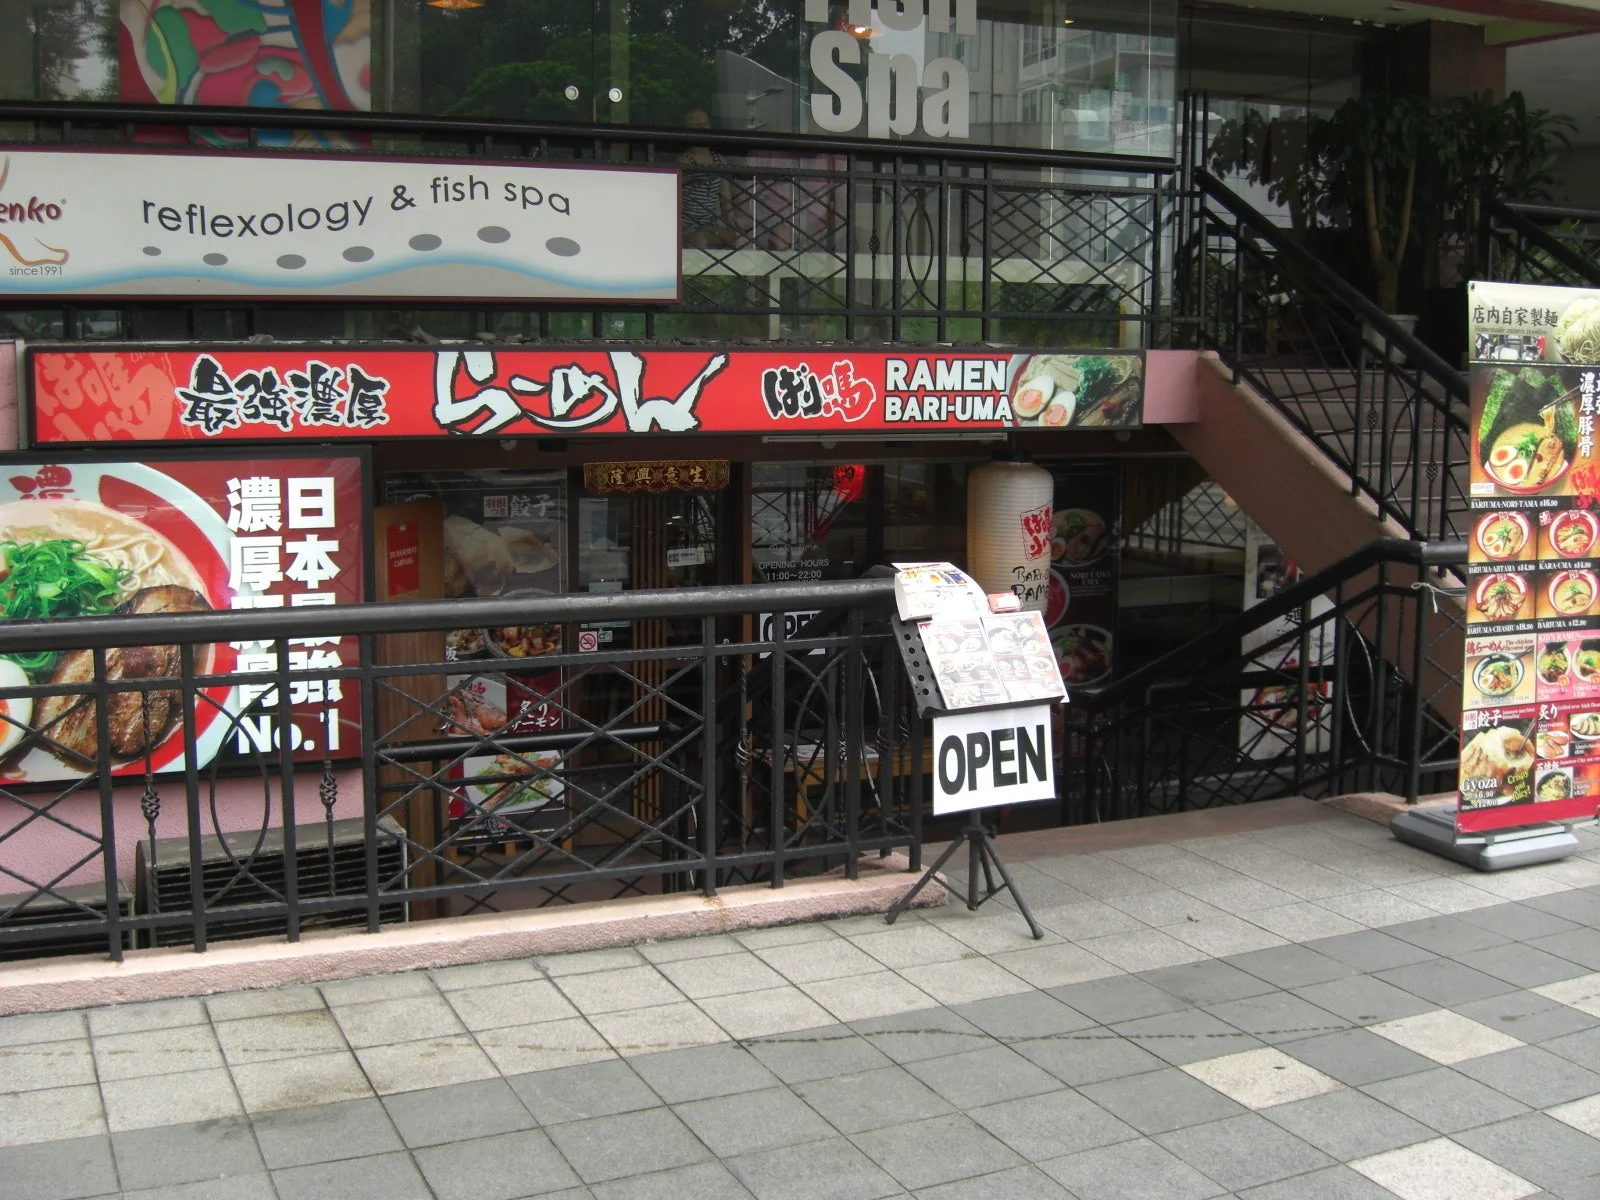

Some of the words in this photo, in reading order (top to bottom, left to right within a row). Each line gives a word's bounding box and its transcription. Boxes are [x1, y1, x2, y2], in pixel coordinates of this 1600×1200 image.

[810, 30, 969, 139] Spa
[142, 197, 373, 238] reflexology
[390, 184, 417, 211] &
[430, 174, 489, 204] fish
[504, 181, 571, 216] spa
[1472, 304, 1559, 328] 店内自家製麺
[885, 359, 1007, 391] RAMEN
[176, 355, 389, 435] 最強濃厚
[432, 351, 728, 435] らーめん
[884, 395, 1014, 421] BARI-UMA
[1577, 371, 1595, 458] 濃厚豚骨
[758, 560, 796, 570] OPENING
[800, 558, 830, 568] HOURS
[1477, 708, 1502, 728] 餃子
[1539, 703, 1558, 720] 炙り
[938, 724, 1048, 796] OPEN
[1461, 777, 1498, 792] Gyoza
